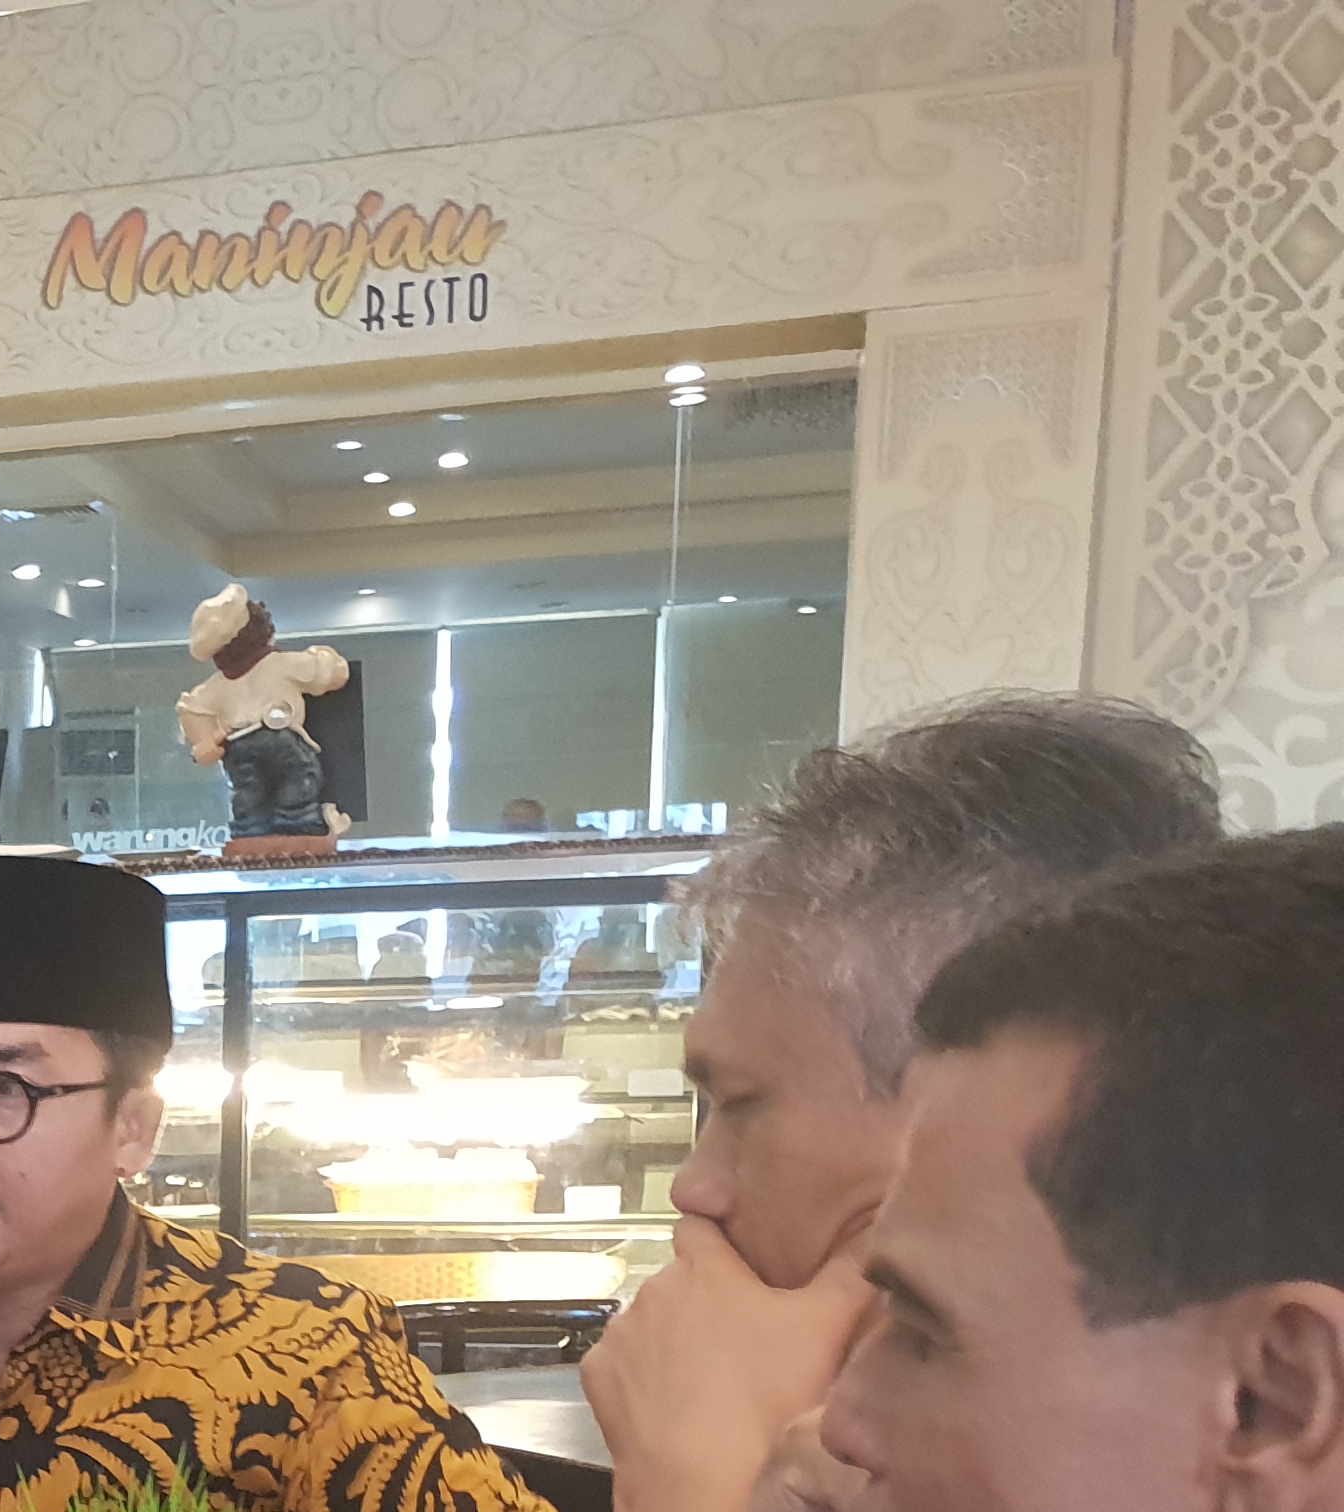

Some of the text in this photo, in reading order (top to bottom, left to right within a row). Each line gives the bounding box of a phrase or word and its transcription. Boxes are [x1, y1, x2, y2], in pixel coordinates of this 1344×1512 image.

[43, 191, 507, 318] Maninjau
[359, 273, 489, 331] RESTO
[72, 819, 233, 853] warungko
